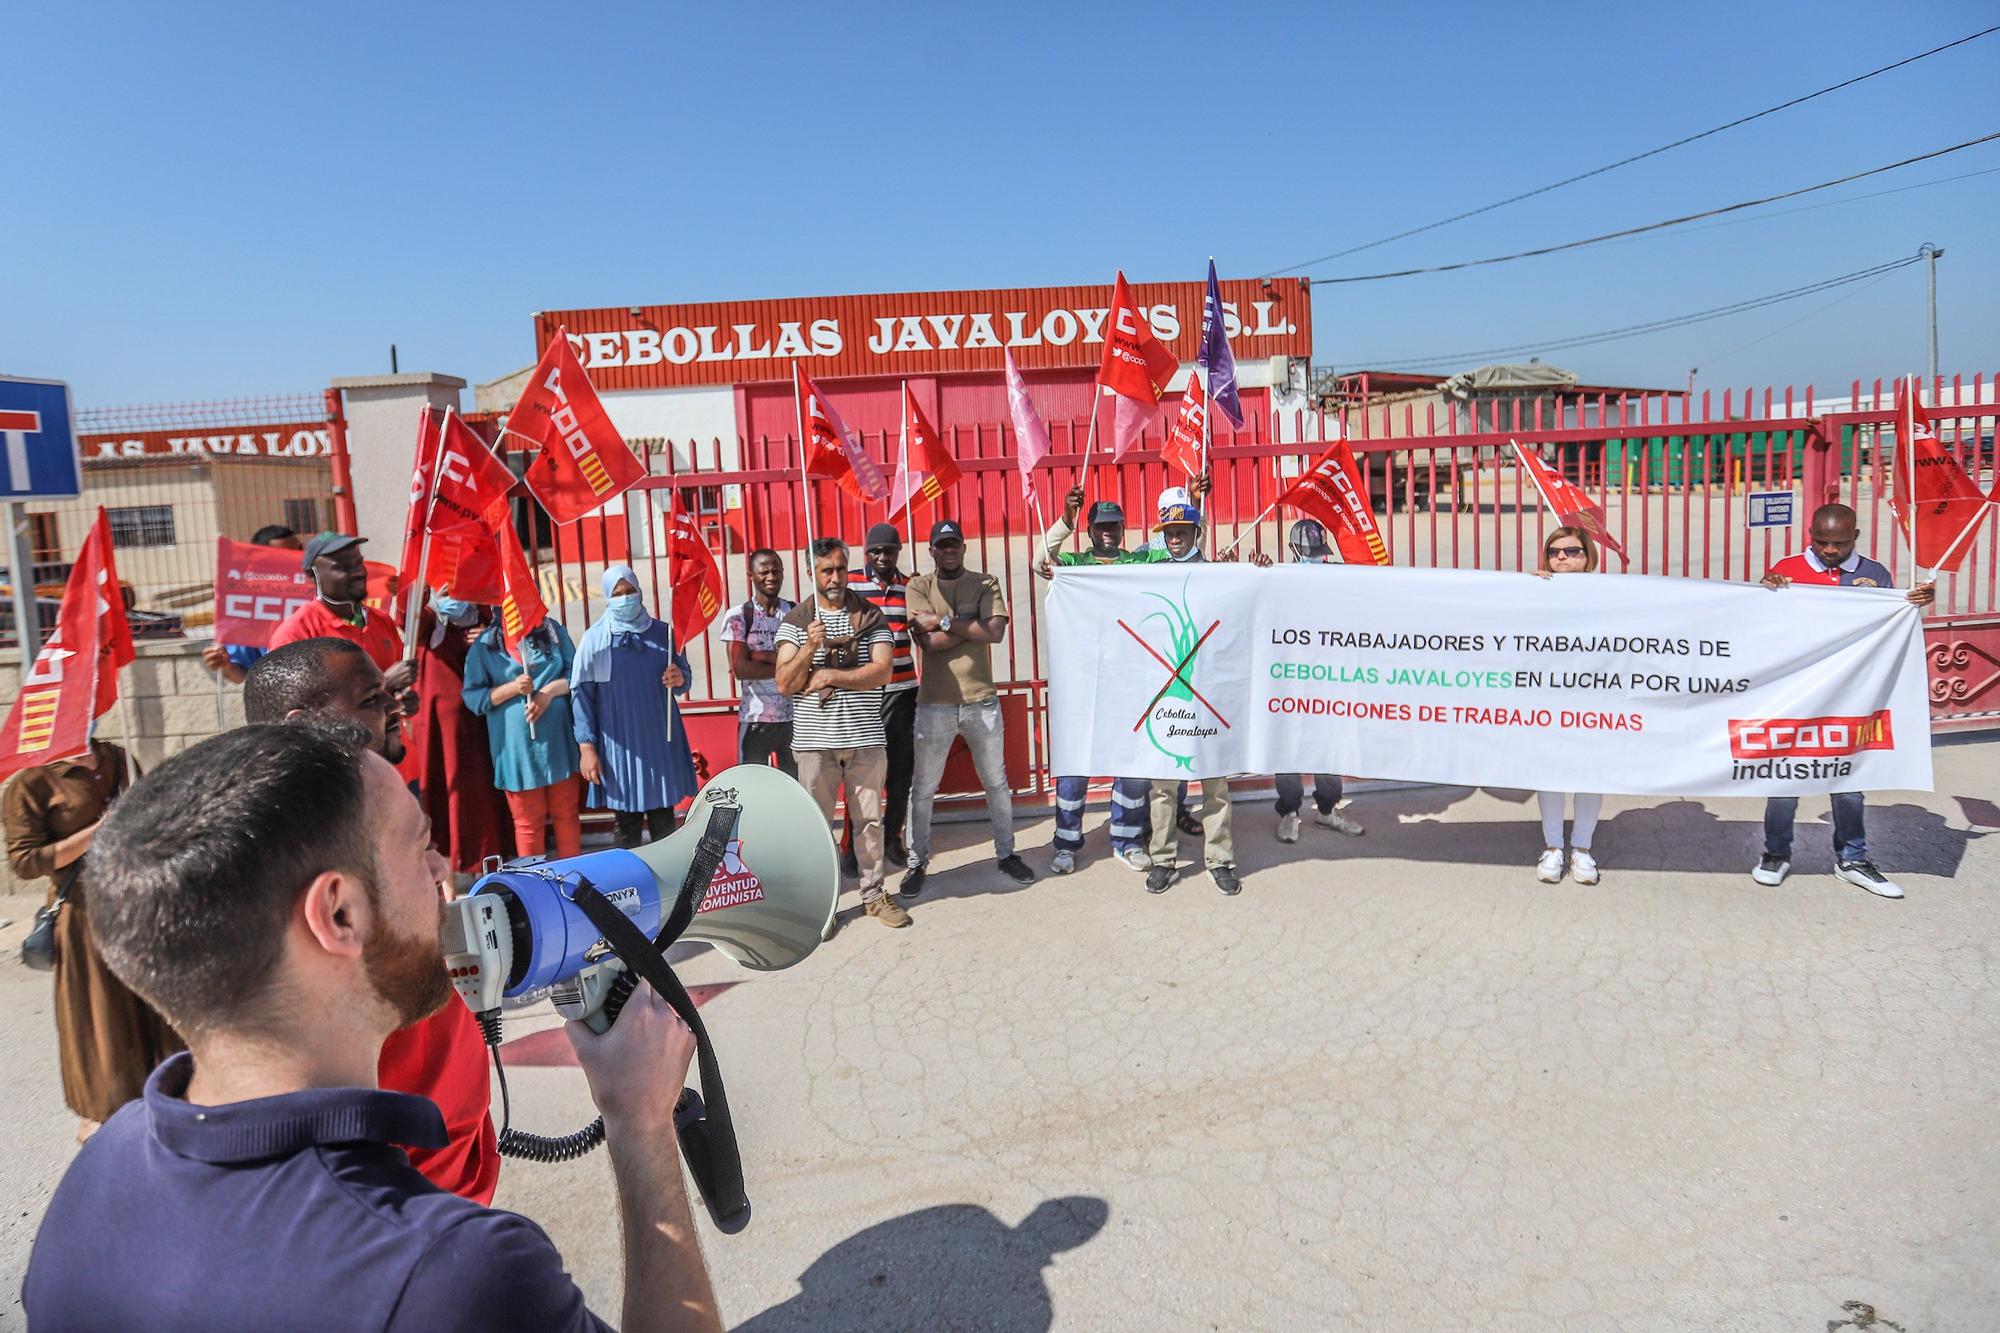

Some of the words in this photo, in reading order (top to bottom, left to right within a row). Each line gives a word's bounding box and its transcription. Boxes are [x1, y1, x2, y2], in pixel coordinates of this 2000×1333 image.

[868, 304, 1181, 354] JAVALOYS
[1316, 459, 1374, 532] CCOO
[1271, 629, 1311, 645] LOS
[1318, 631, 1485, 651] TRABAJADORES
[1493, 635, 1507, 651] Y
[1513, 635, 1690, 656] TRABAJADORAS
[1700, 640, 1731, 657] DE
[1270, 662, 1379, 684] CEBOLLAS
[1386, 669, 1513, 688] JAVALOYES
[1515, 671, 1543, 688] EN
[1549, 671, 1622, 690] LUCHA
[1630, 674, 1681, 693] POR
[1688, 677, 1751, 695] UNAS
[1155, 707, 1196, 720] Cebollas
[1268, 697, 1412, 721] CONDICIONES
[1418, 705, 1448, 723] DE
[1452, 706, 1553, 728] TRABAJO
[1560, 711, 1644, 732] DIGNAS
[1166, 724, 1218, 739] Javaloyes
[1739, 725, 1849, 751] CCOO
[1732, 757, 1852, 781] indústria
[704, 877, 759, 899] UVENTUD
